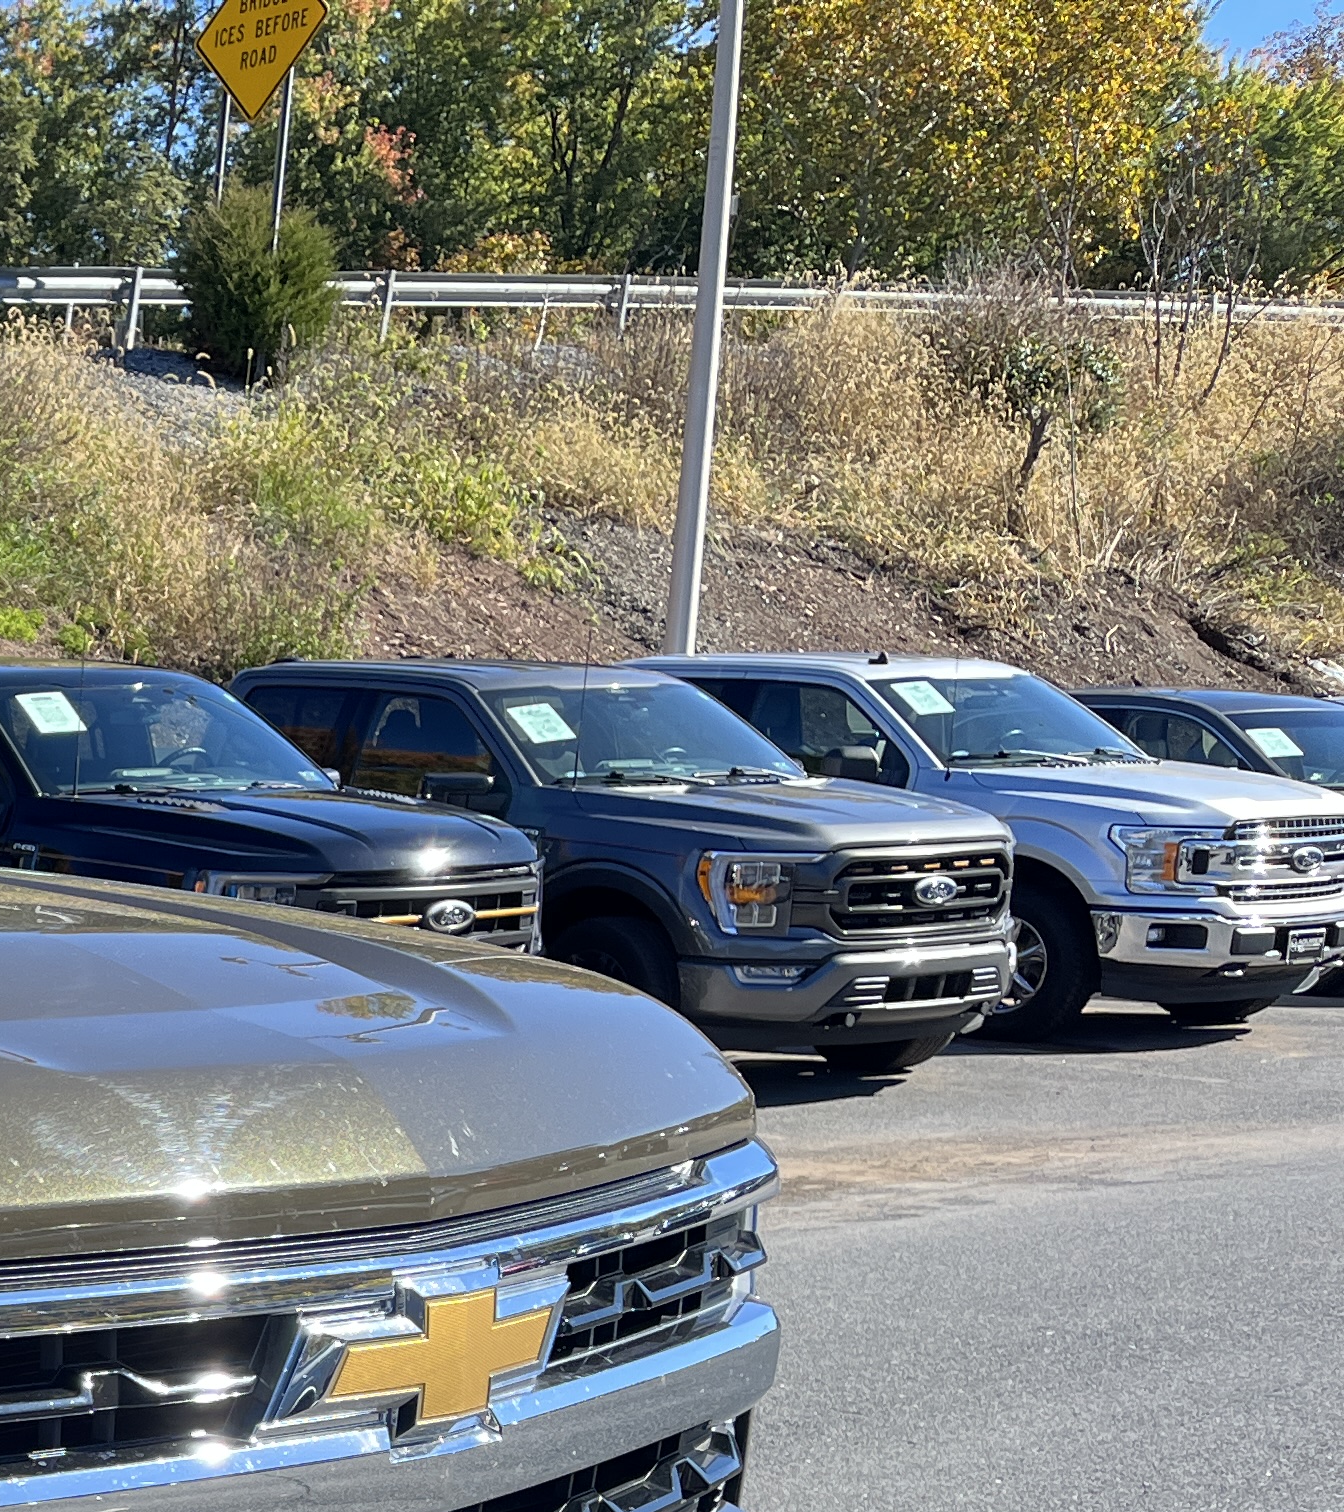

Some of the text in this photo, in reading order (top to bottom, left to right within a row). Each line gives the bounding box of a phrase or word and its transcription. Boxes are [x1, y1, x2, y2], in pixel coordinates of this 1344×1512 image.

[239, 0, 288, 14] BRI
[214, 8, 308, 48] ICES BEFORE
[239, 45, 277, 70] ROAD
